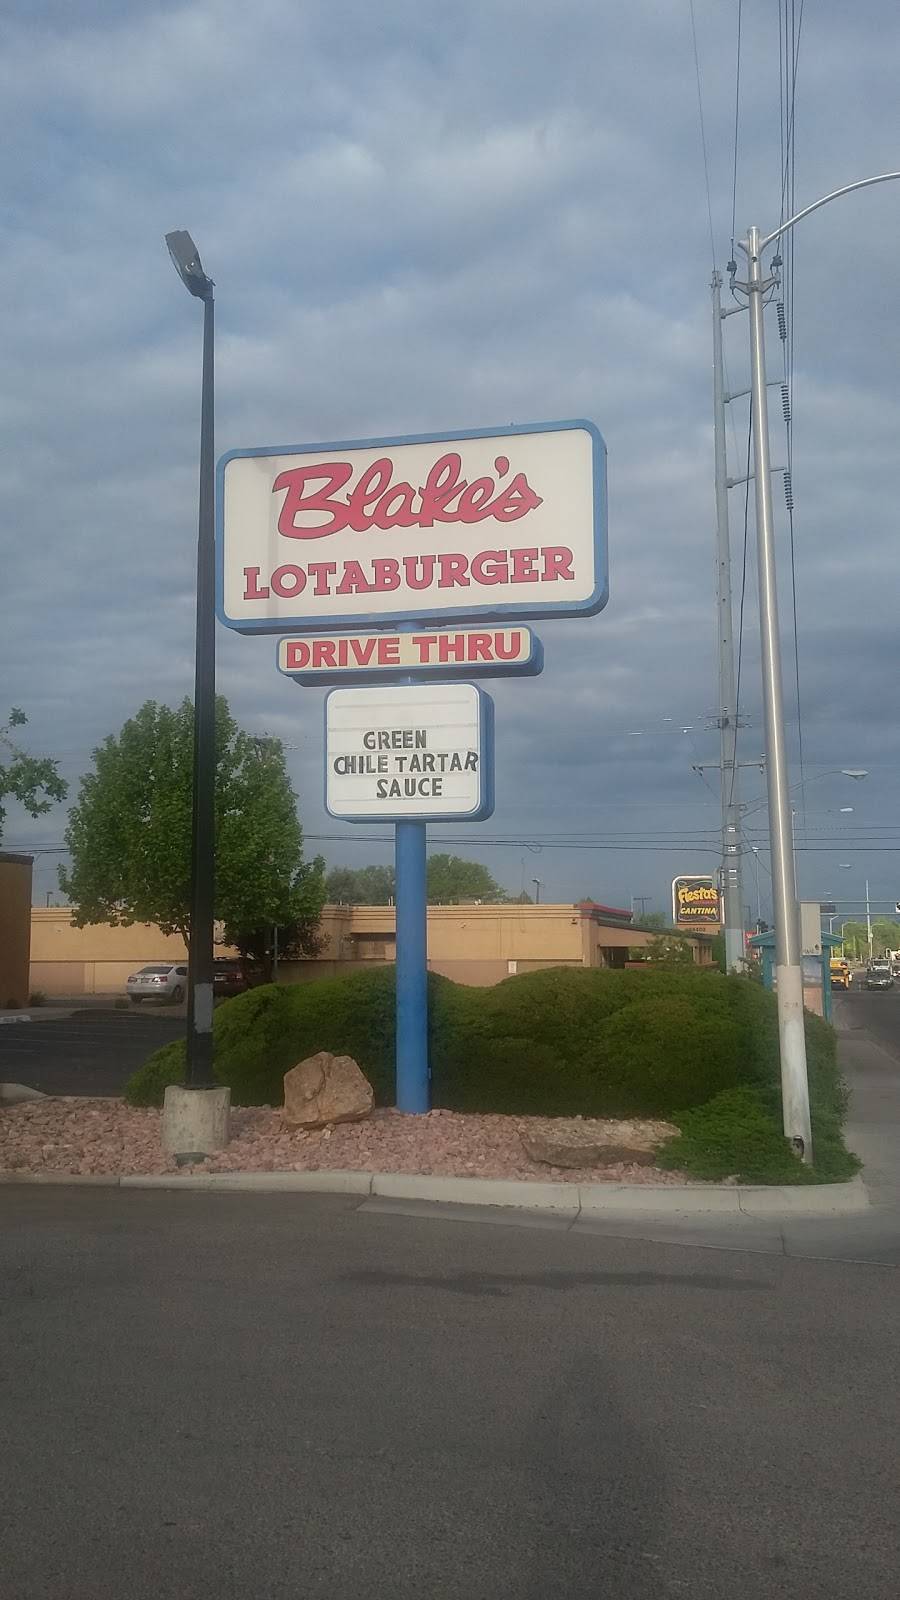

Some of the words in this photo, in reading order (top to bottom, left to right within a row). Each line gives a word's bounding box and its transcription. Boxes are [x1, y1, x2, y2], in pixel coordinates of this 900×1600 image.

[271, 453, 543, 540] Blake's
[243, 546, 575, 600] LOTABURGER
[286, 638, 400, 668] DRIVE
[412, 631, 521, 663] THRU
[363, 730, 427, 750] GREEN
[333, 755, 389, 775] CHILE
[395, 752, 479, 773] TARTAR
[376, 778, 443, 799] SAUCE
